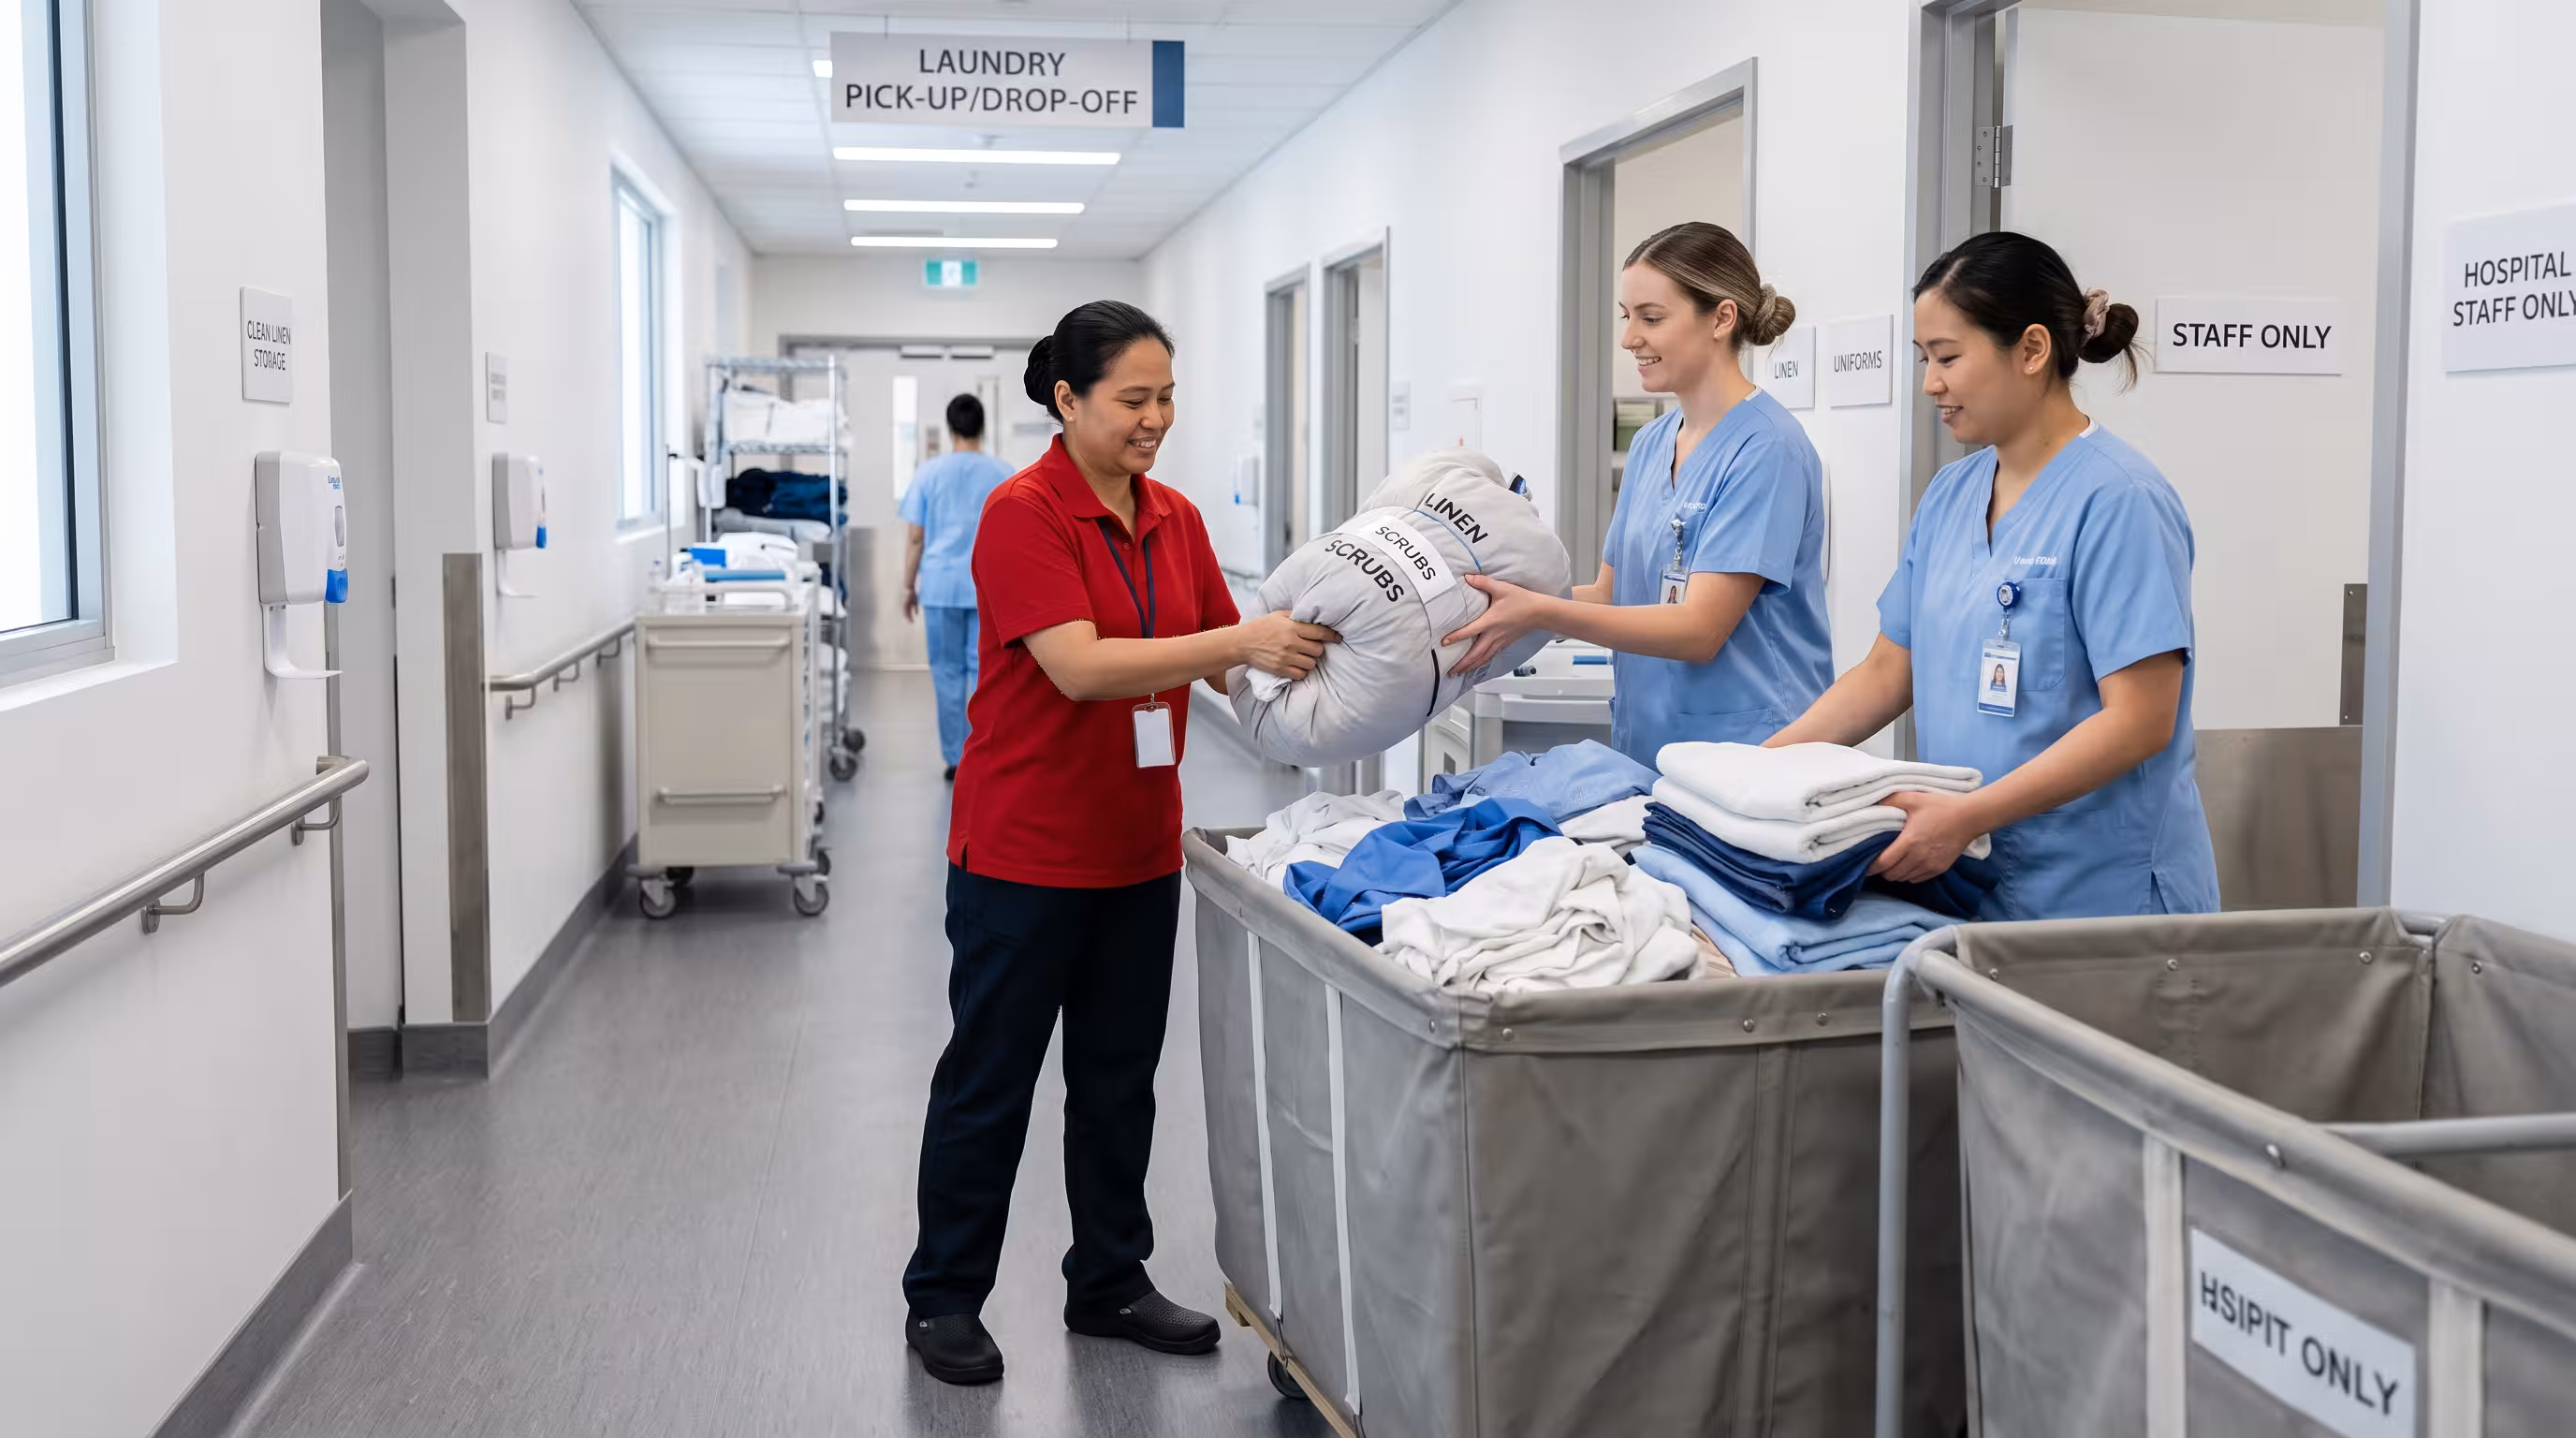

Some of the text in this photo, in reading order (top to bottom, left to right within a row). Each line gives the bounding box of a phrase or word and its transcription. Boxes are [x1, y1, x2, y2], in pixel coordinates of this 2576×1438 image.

[919, 49, 1066, 77] LAUNDRY
[845, 83, 1139, 114] PICK-UP/DROP-OFF
[2465, 251, 2571, 287] HOSPITAL
[2453, 296, 2516, 327] STAFF
[246, 320, 291, 345] CLEAN LINEN
[2173, 323, 2332, 349] STAFF ONLY
[254, 348, 285, 371] STORAGE
[1774, 360, 1799, 379] LINEN
[1834, 350, 1882, 373] UNIFORMS
[1424, 492, 1489, 544] LINEN
[1375, 526, 1436, 580] SCRUBS
[1325, 539, 1405, 602] SCRUBS
[2301, 1336, 2399, 1416] ONLY
